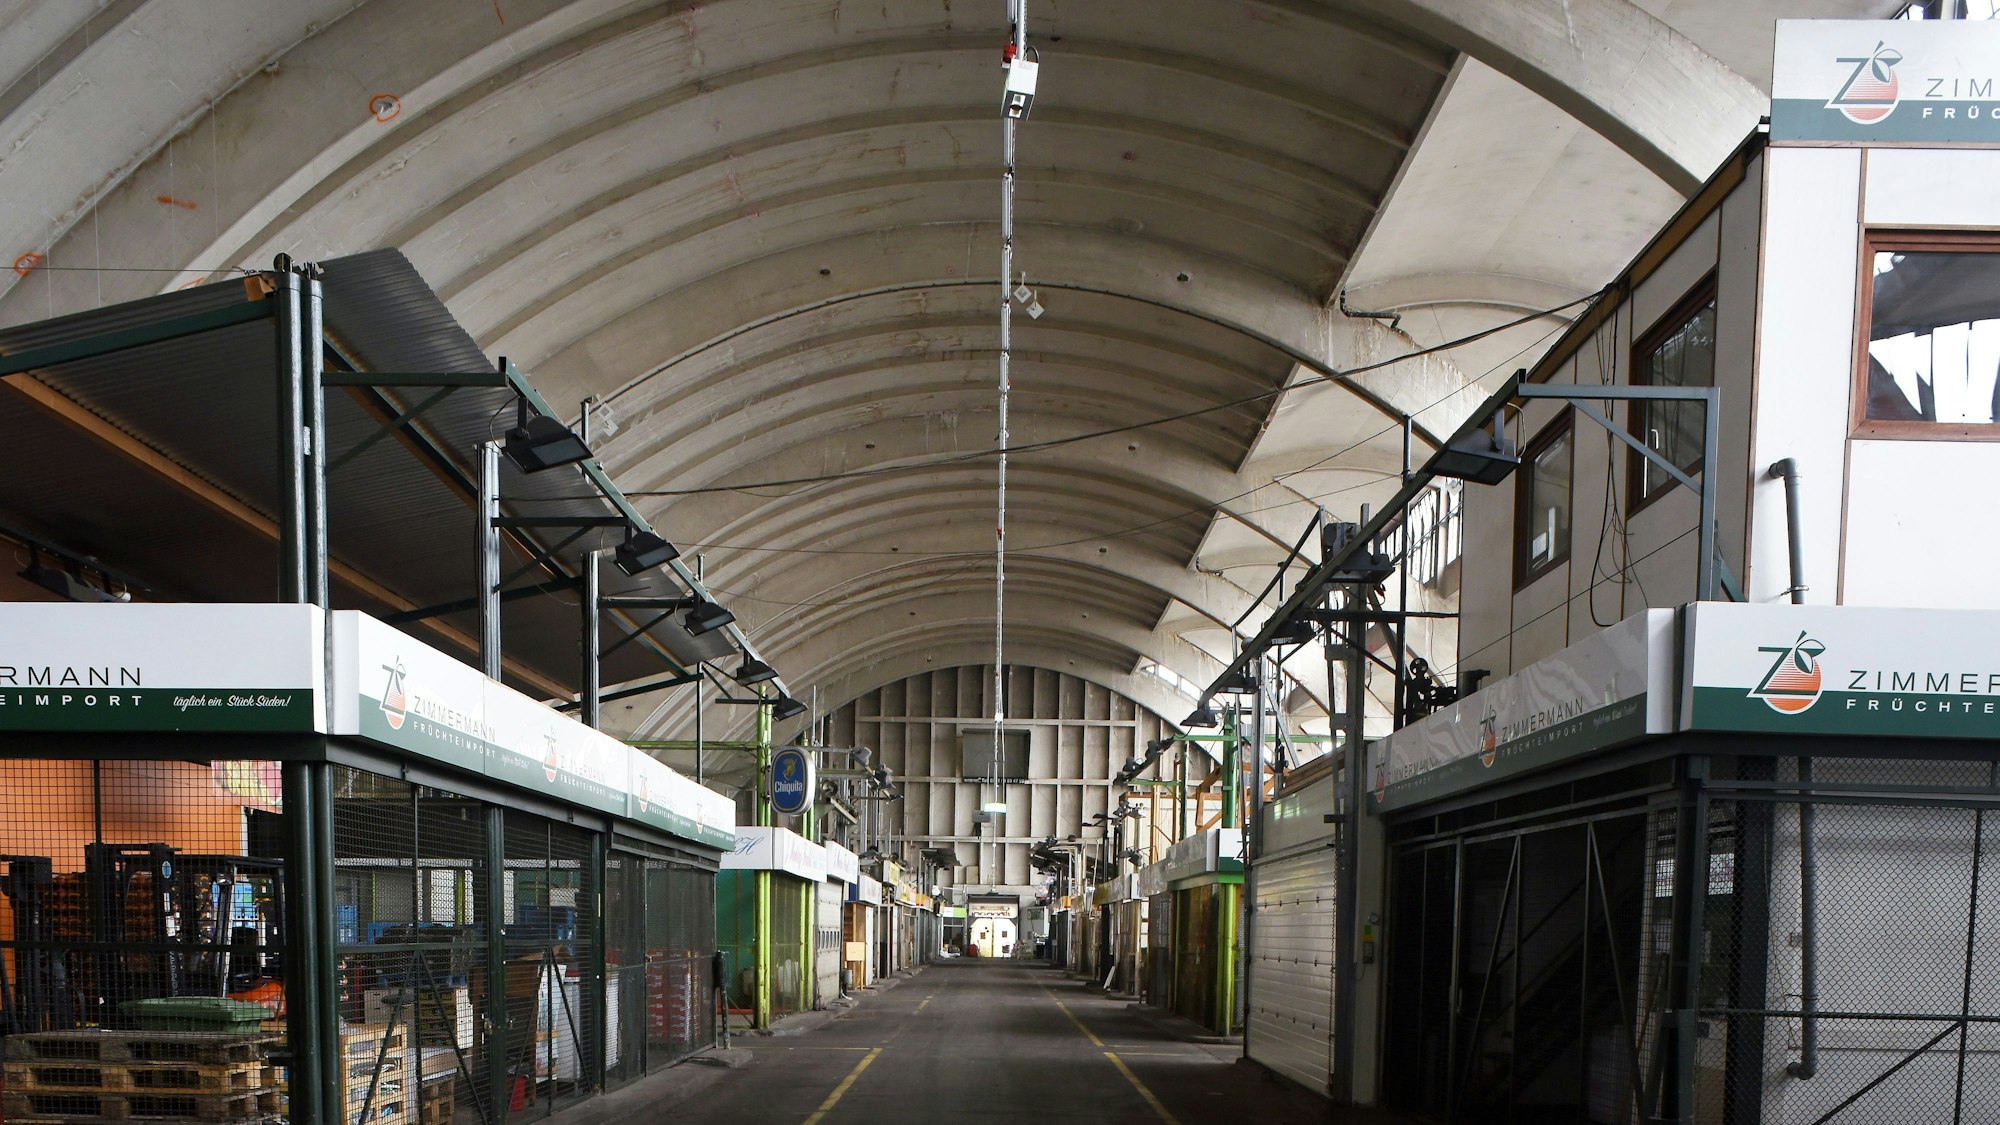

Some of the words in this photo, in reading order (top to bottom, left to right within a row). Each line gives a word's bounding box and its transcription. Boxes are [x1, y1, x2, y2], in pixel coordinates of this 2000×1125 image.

[1925, 78, 1992, 97] ZIM
[173, 694, 206, 712] täglich
[207, 698, 223, 707] ein
[227, 694, 254, 707] Stück
[255, 694, 292, 707] Süden!
[1846, 697, 1994, 714] FRÜCHTE
[414, 695, 496, 743] ZIMMERMANN
[1502, 697, 1583, 743] ZIMMERMANN
[774, 780, 803, 794] Chiquita
